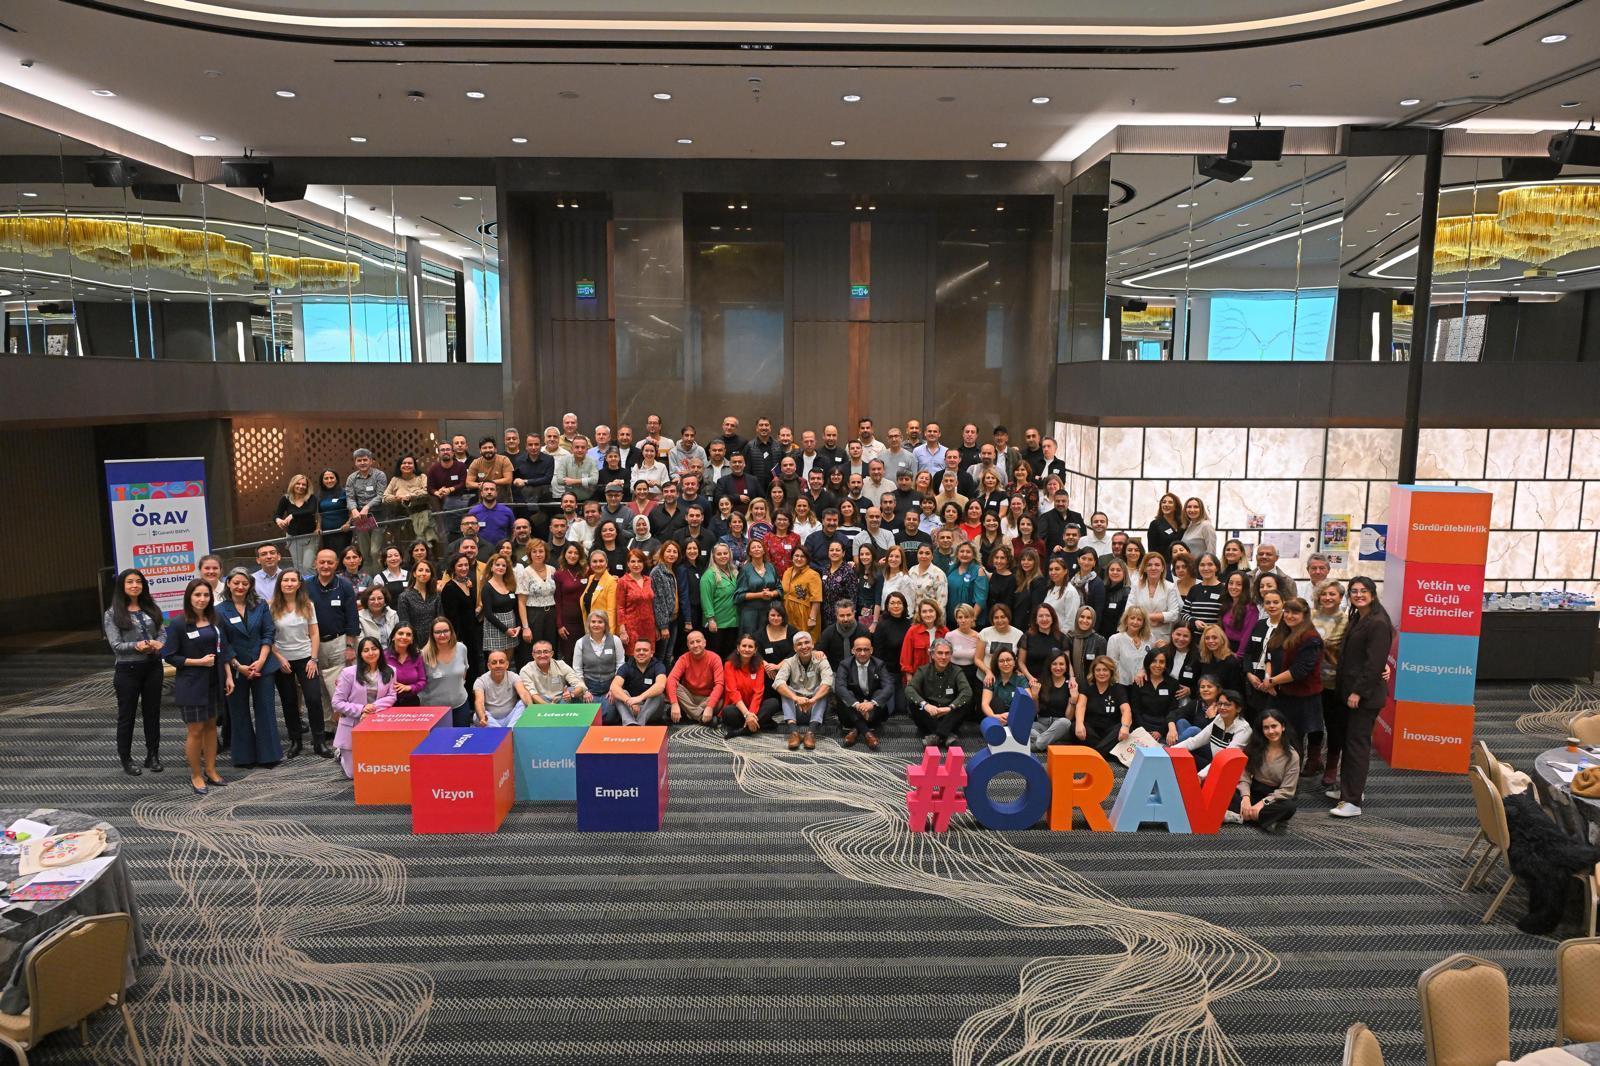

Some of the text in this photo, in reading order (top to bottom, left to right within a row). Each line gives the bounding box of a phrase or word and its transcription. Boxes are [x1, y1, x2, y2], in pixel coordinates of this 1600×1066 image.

[132, 504, 188, 527] ÖRAV
[1412, 523, 1487, 533] Sürdürülebilirlik
[138, 543, 188, 555] EĞİTİMDE
[140, 554, 189, 567] VİZYON
[1416, 579, 1471, 592] Yetkin ve
[1424, 593, 1460, 606] Güçlü
[1408, 605, 1474, 618] Eğitimciler
[1401, 661, 1473, 676] Kapsayıcılık
[1403, 728, 1462, 744] İnovasyon
[357, 762, 411, 774] Kapsayıc
[531, 759, 576, 769] Liderlik
[432, 788, 474, 801] Vizyon
[595, 786, 639, 799] Empati
